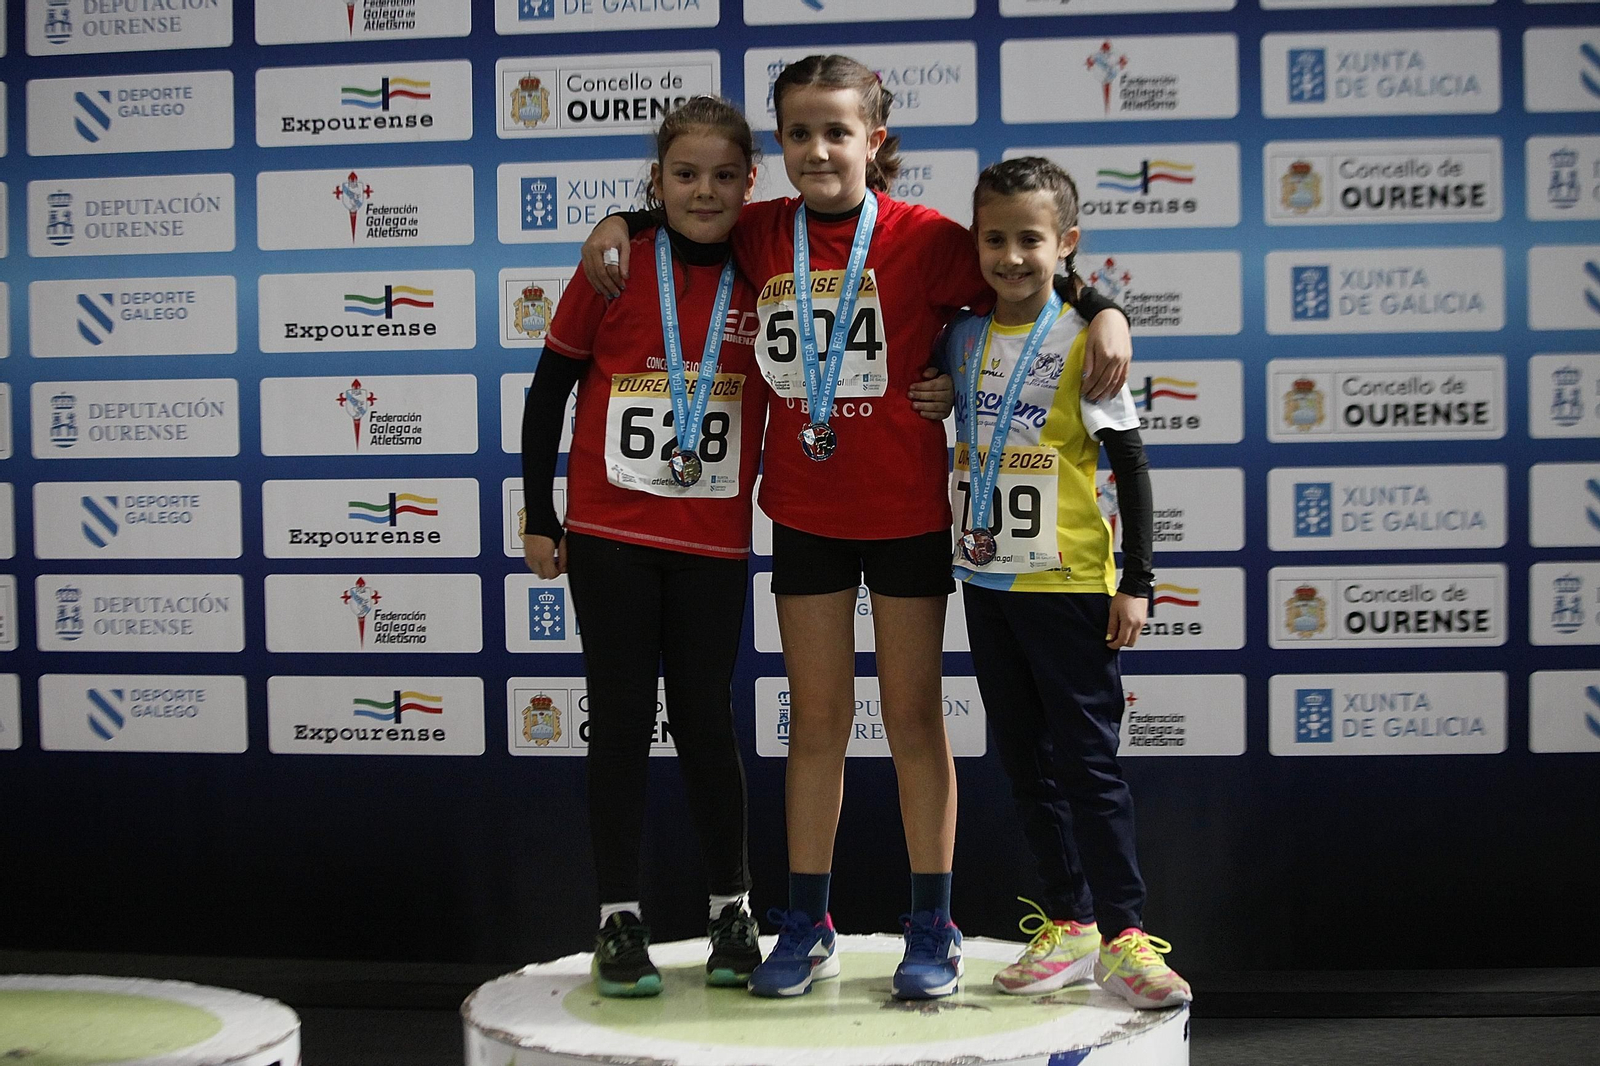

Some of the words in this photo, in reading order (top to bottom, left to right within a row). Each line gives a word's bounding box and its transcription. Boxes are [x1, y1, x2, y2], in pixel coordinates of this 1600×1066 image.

[364, 8, 404, 20] Galega
[406, 10, 415, 18] de
[82, 16, 181, 36] OURENSE
[364, 19, 415, 30] Atletismo
[1338, 50, 1424, 72] XUNTA
[567, 73, 652, 92] Concello
[660, 71, 682, 89] de
[1335, 76, 1367, 98] DE
[1377, 74, 1481, 97] GALICIA
[118, 87, 193, 101] DEPORTE
[118, 103, 185, 118] GALEGO
[567, 97, 686, 122] OUREN
[282, 115, 433, 134] Expourense
[1339, 159, 1432, 179] Concello
[1438, 159, 1462, 177] de
[85, 193, 220, 217] DEPUTACIÓN
[1341, 184, 1484, 209] OURENSE
[366, 203, 418, 216] Federación
[567, 206, 595, 224] DE
[1082, 198, 1197, 215] ourense
[84, 220, 183, 239] OURENSE
[366, 215, 407, 228] Galega
[367, 226, 418, 238] Atletismo
[660, 246, 668, 281] ATLETISMO
[664, 282, 670, 291] DE
[1341, 267, 1428, 290] XUNTA
[762, 277, 838, 299] OURSE
[1124, 290, 1180, 304] Federación
[121, 291, 195, 305] DEPORTE
[664, 292, 672, 320] GALEGA
[719, 286, 728, 310] GALEGA
[1340, 294, 1371, 315] DE
[1381, 292, 1484, 315] GALICIA
[121, 307, 187, 321] GALEGO
[285, 323, 436, 341] Expourense
[833, 331, 844, 350] FGA
[805, 343, 815, 361] FGA
[703, 360, 714, 377] FGA
[825, 356, 837, 395] ATLETISMO
[672, 372, 682, 391] FGA
[710, 380, 739, 395] 025
[810, 369, 818, 407] TLETISMO
[1343, 377, 1435, 396] Concello
[1441, 377, 1465, 394] de
[89, 398, 224, 419] DEPUTACIÓN
[694, 384, 707, 422] ATLETISMO
[801, 400, 873, 418] BRCO
[822, 396, 829, 406] DE
[369, 411, 421, 422] Federación
[677, 398, 686, 435] TLETISMO
[819, 406, 827, 422] EGA
[1344, 402, 1487, 426] OURENSE
[89, 424, 188, 441] OURENSE
[370, 423, 411, 436] Galega
[691, 423, 698, 433] DE
[370, 434, 422, 445] Atletismo
[1009, 453, 1055, 469] 2025
[980, 500, 986, 510] DE
[984, 460, 995, 499] ATLETISMO
[991, 435, 1002, 454] FGA
[125, 495, 199, 508] DEPORTE
[1343, 485, 1430, 507] XUNTA
[125, 511, 192, 524] GALEGO
[1342, 512, 1373, 532] DE
[1383, 510, 1486, 532] GALICIA
[289, 529, 440, 547] Expourense
[94, 593, 228, 613] DEPUTACIÓN
[1344, 585, 1436, 603] Concello
[1442, 585, 1467, 602] de
[374, 609, 426, 622] Federación
[1346, 610, 1488, 634] OURENSE
[94, 619, 193, 635] OURENSE
[374, 620, 415, 634] Galega
[375, 632, 426, 643] Atletismo
[131, 689, 204, 702] DEPORTE
[1344, 692, 1431, 712] XUNTA
[131, 705, 198, 718] GALEGO
[1128, 711, 1184, 725] Federación
[294, 725, 445, 743] Expourense
[1128, 723, 1172, 737] Galega
[1343, 718, 1374, 737] DE
[1384, 717, 1486, 737] GALICIA
[1129, 735, 1184, 746] Atletismo
